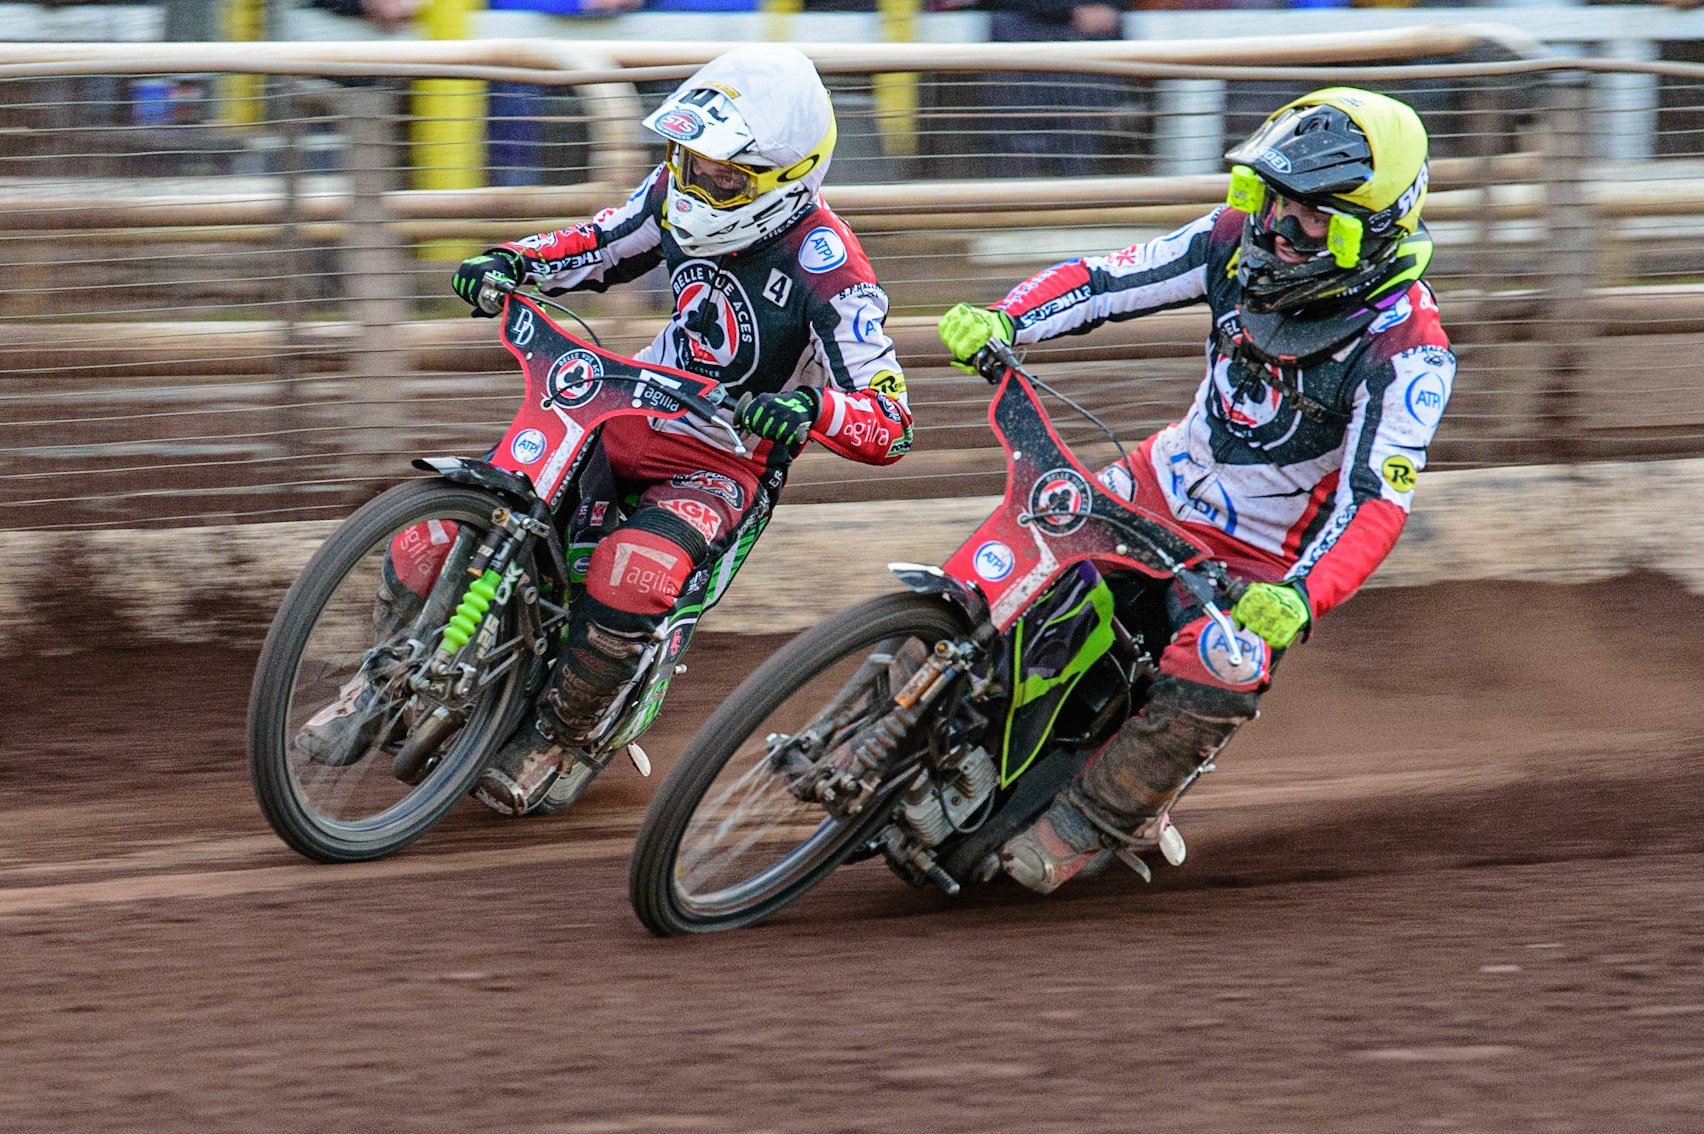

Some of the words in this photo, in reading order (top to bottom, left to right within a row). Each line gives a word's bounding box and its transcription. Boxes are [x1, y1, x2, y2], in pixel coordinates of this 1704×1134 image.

[662, 114, 697, 133] STS
[810, 236, 836, 263] ATPI
[769, 275, 786, 305] 4
[672, 267, 705, 295] BELLE
[708, 269, 735, 297] VUE
[732, 301, 754, 344] ACES
[558, 352, 580, 367] BELLE
[1415, 389, 1441, 410] ATPI
[518, 438, 539, 454] ATPI
[660, 501, 719, 534] NGK
[982, 551, 1006, 573] ATPI
[1211, 634, 1257, 662] API
